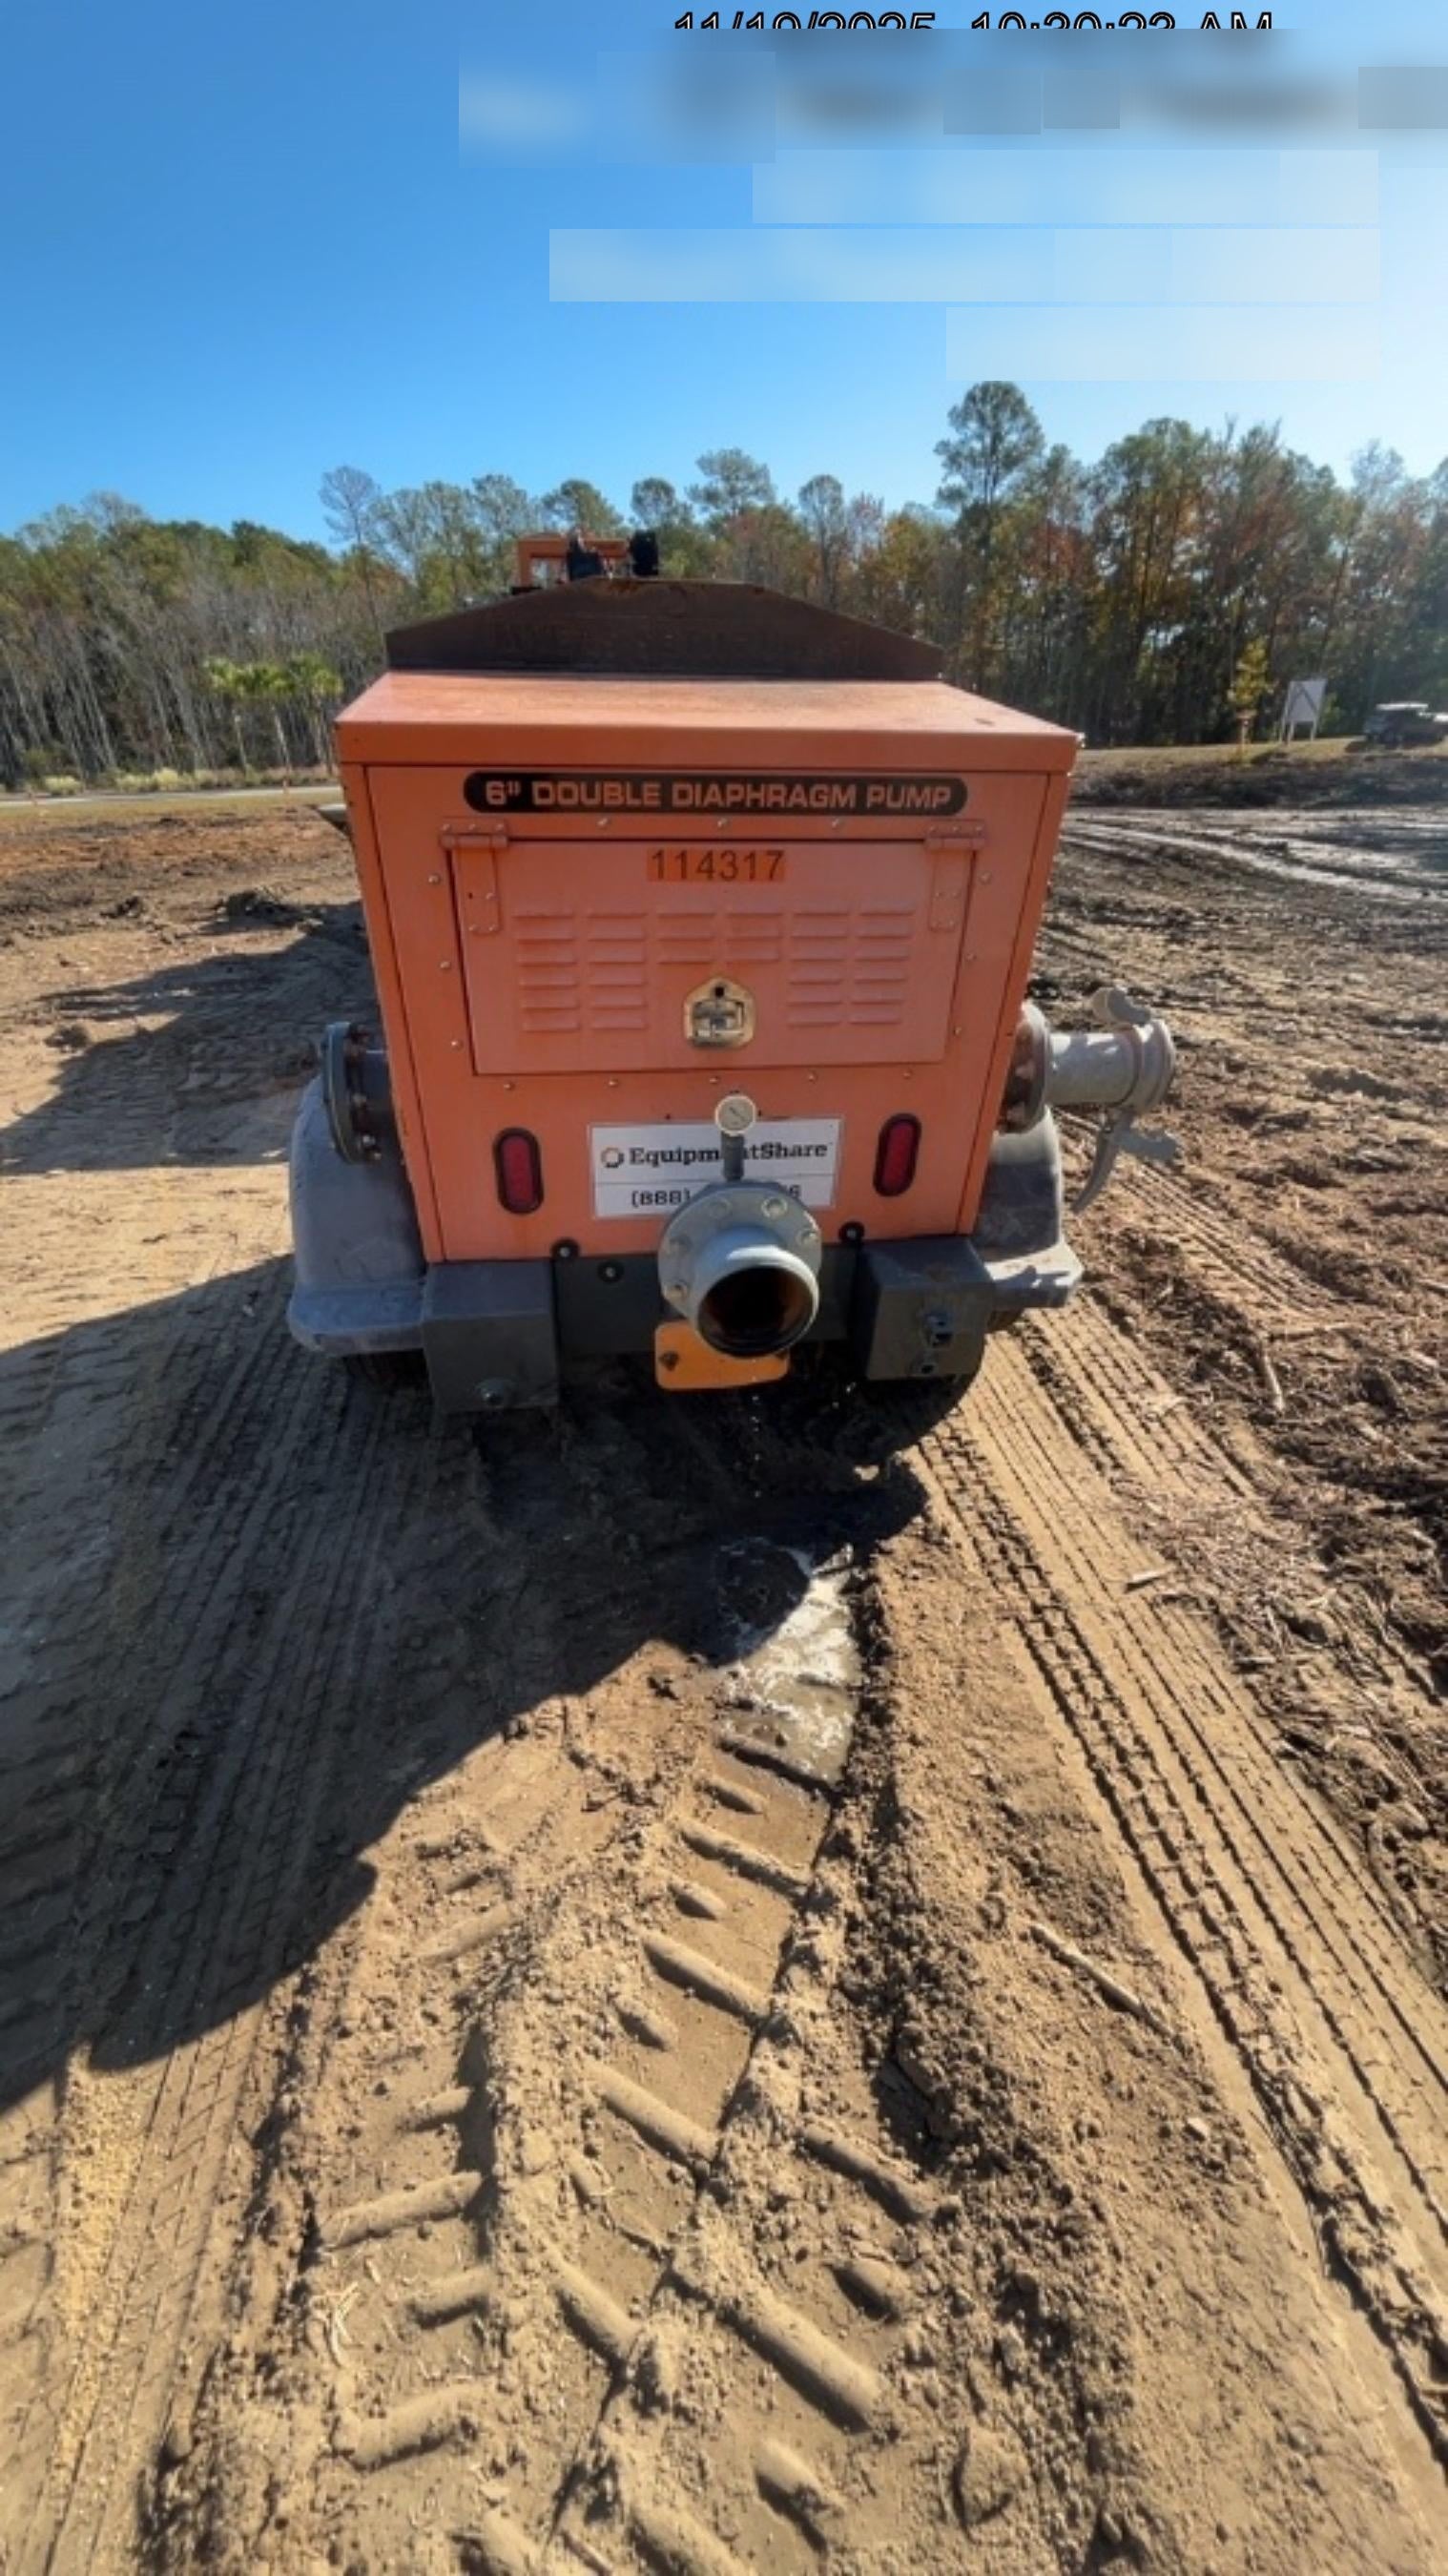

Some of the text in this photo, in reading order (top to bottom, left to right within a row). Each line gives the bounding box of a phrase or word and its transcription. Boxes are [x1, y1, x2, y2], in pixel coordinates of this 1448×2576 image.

[531, 780, 661, 806] DOUBLE
[672, 781, 856, 808] DIAPHRAGM
[866, 785, 951, 809] PUMP
[652, 849, 785, 882] 114317
[630, 1141, 828, 1167] EquipmtShare
